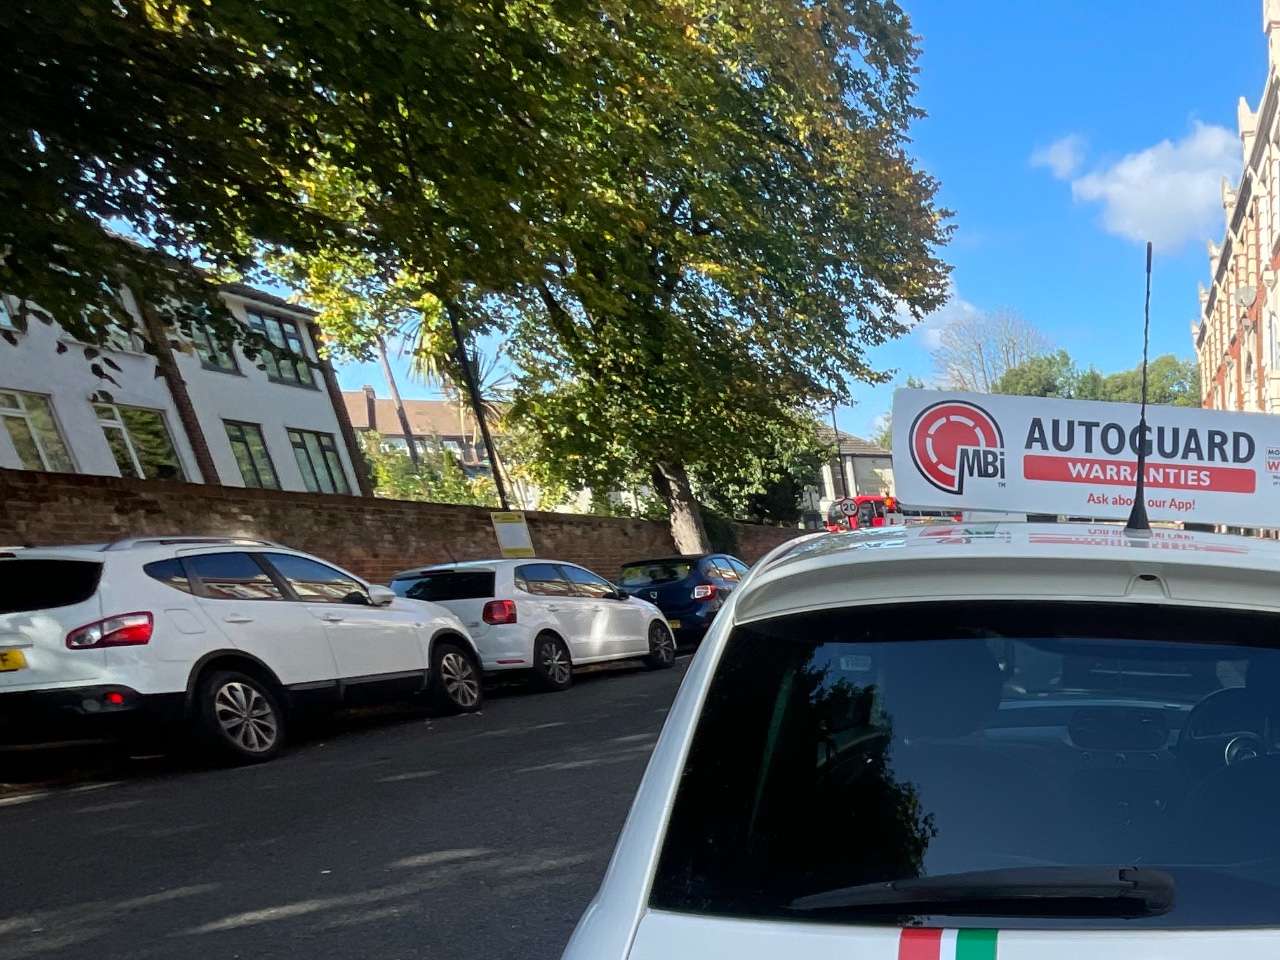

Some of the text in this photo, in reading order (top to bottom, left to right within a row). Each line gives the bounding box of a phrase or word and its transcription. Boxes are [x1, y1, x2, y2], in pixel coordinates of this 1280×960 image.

[1024, 417, 1256, 464] AUTOGUARD
[842, 502, 856, 512] 20
[1087, 493, 1196, 513] Ask abo our App!
